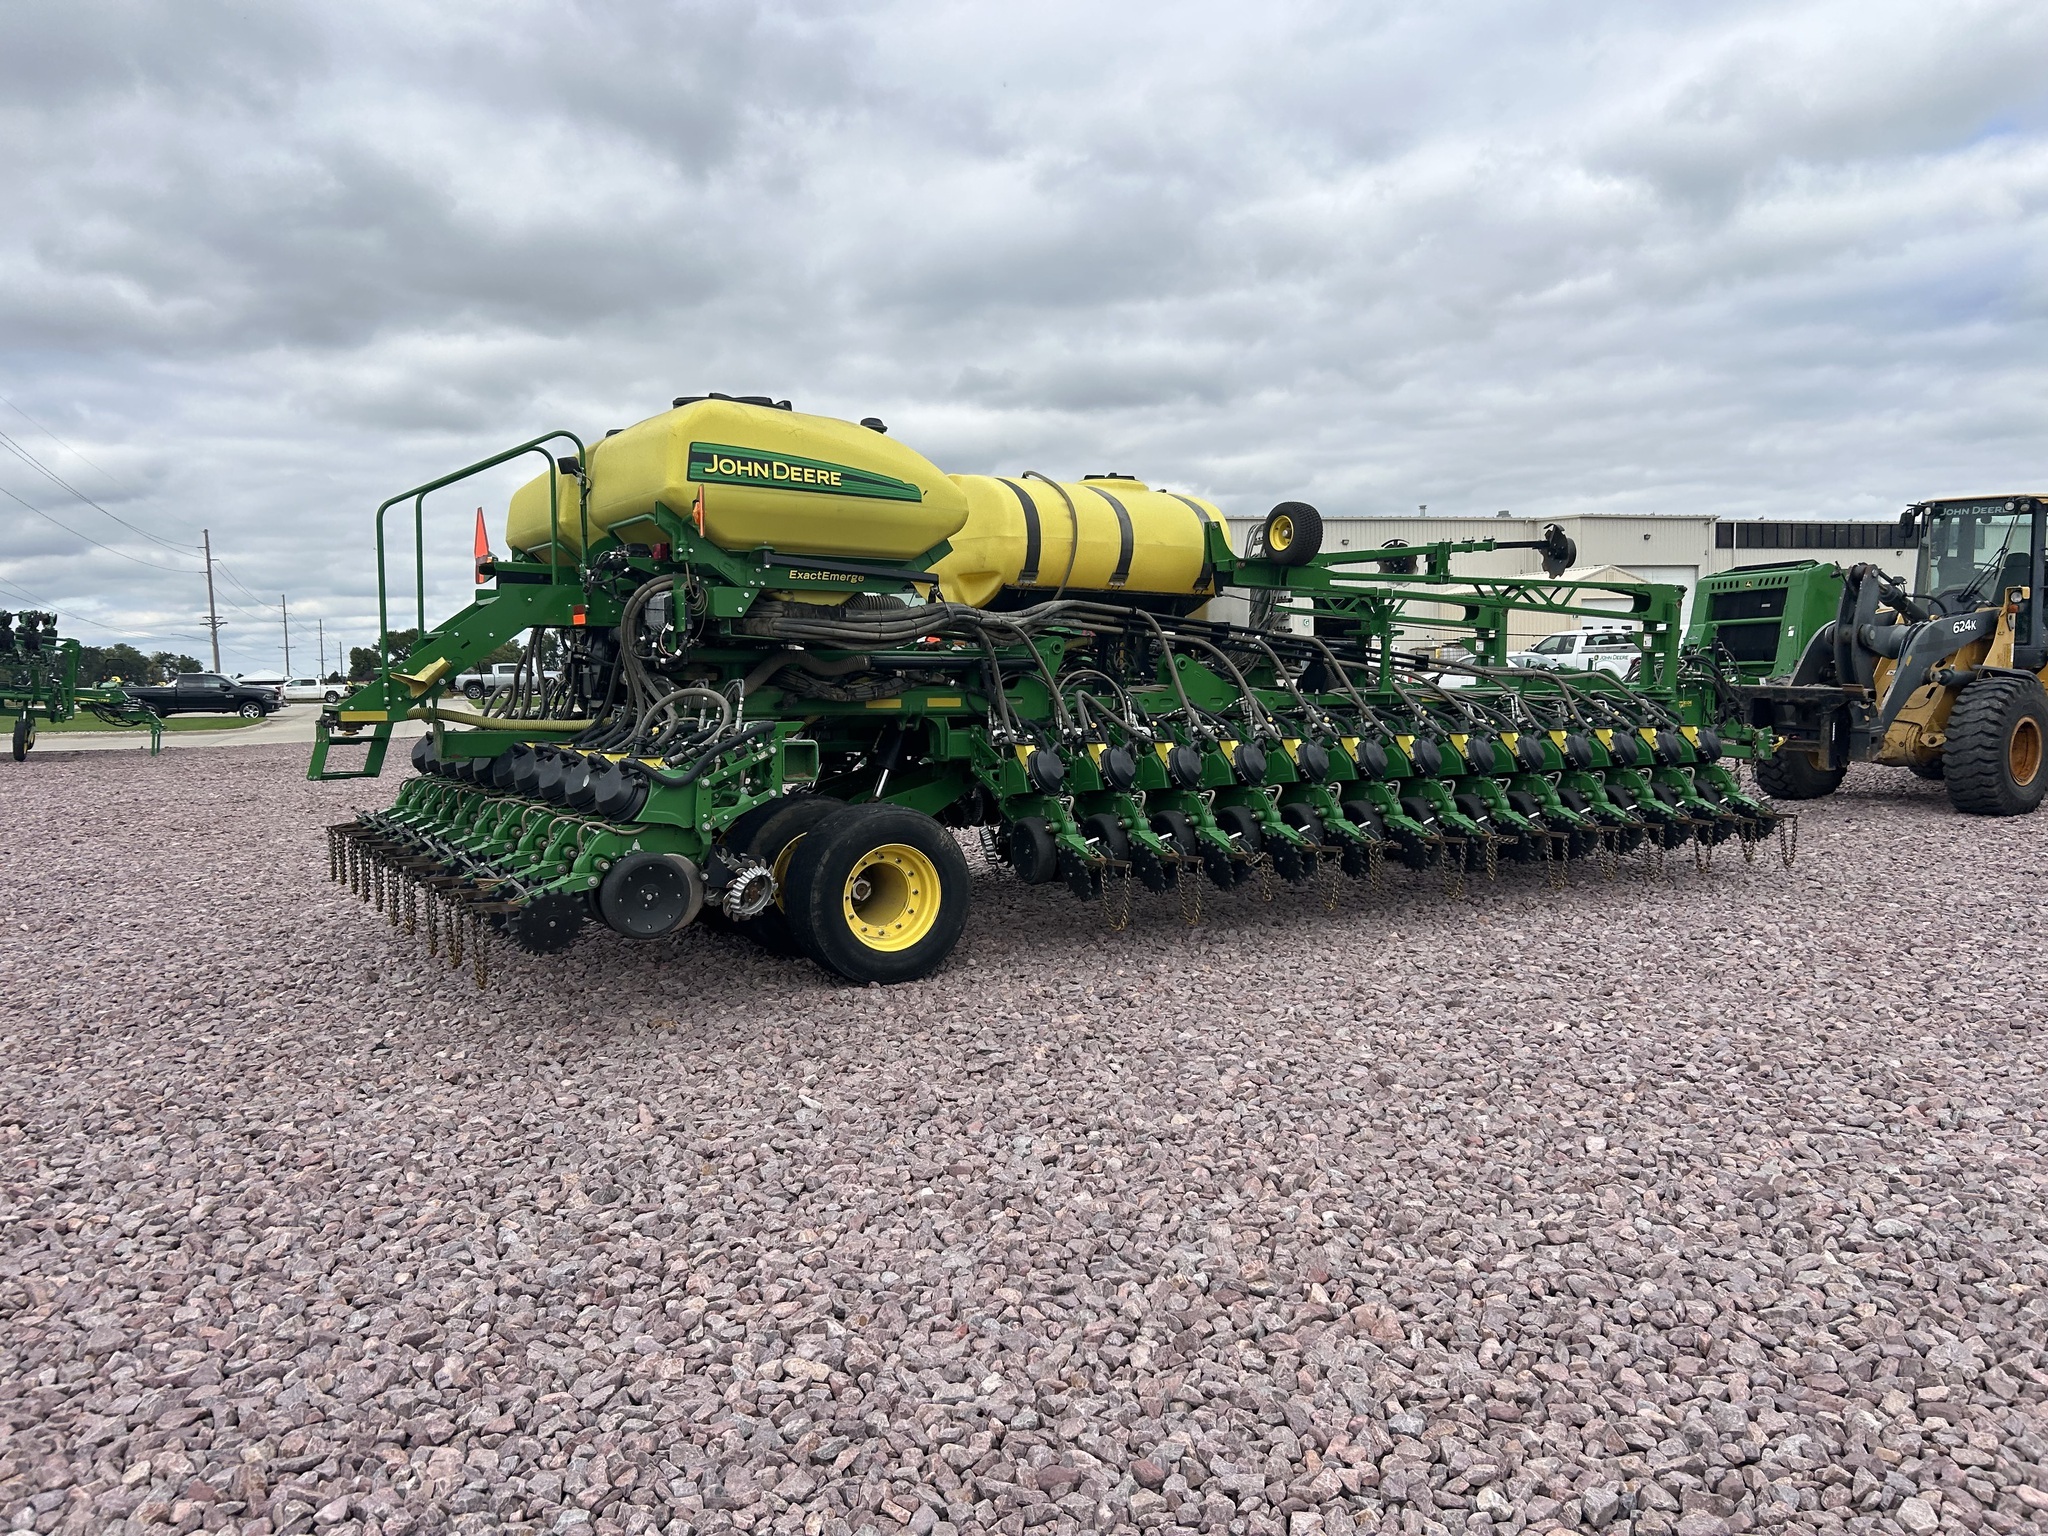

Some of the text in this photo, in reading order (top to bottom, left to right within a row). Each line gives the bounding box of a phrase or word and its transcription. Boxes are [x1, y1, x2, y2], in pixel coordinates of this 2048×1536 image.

[704, 454, 842, 487] JOHN DEERE
[1940, 508, 1970, 516] JOHN
[789, 570, 865, 584] ExactEmerge
[1953, 619, 1977, 634] 624K
